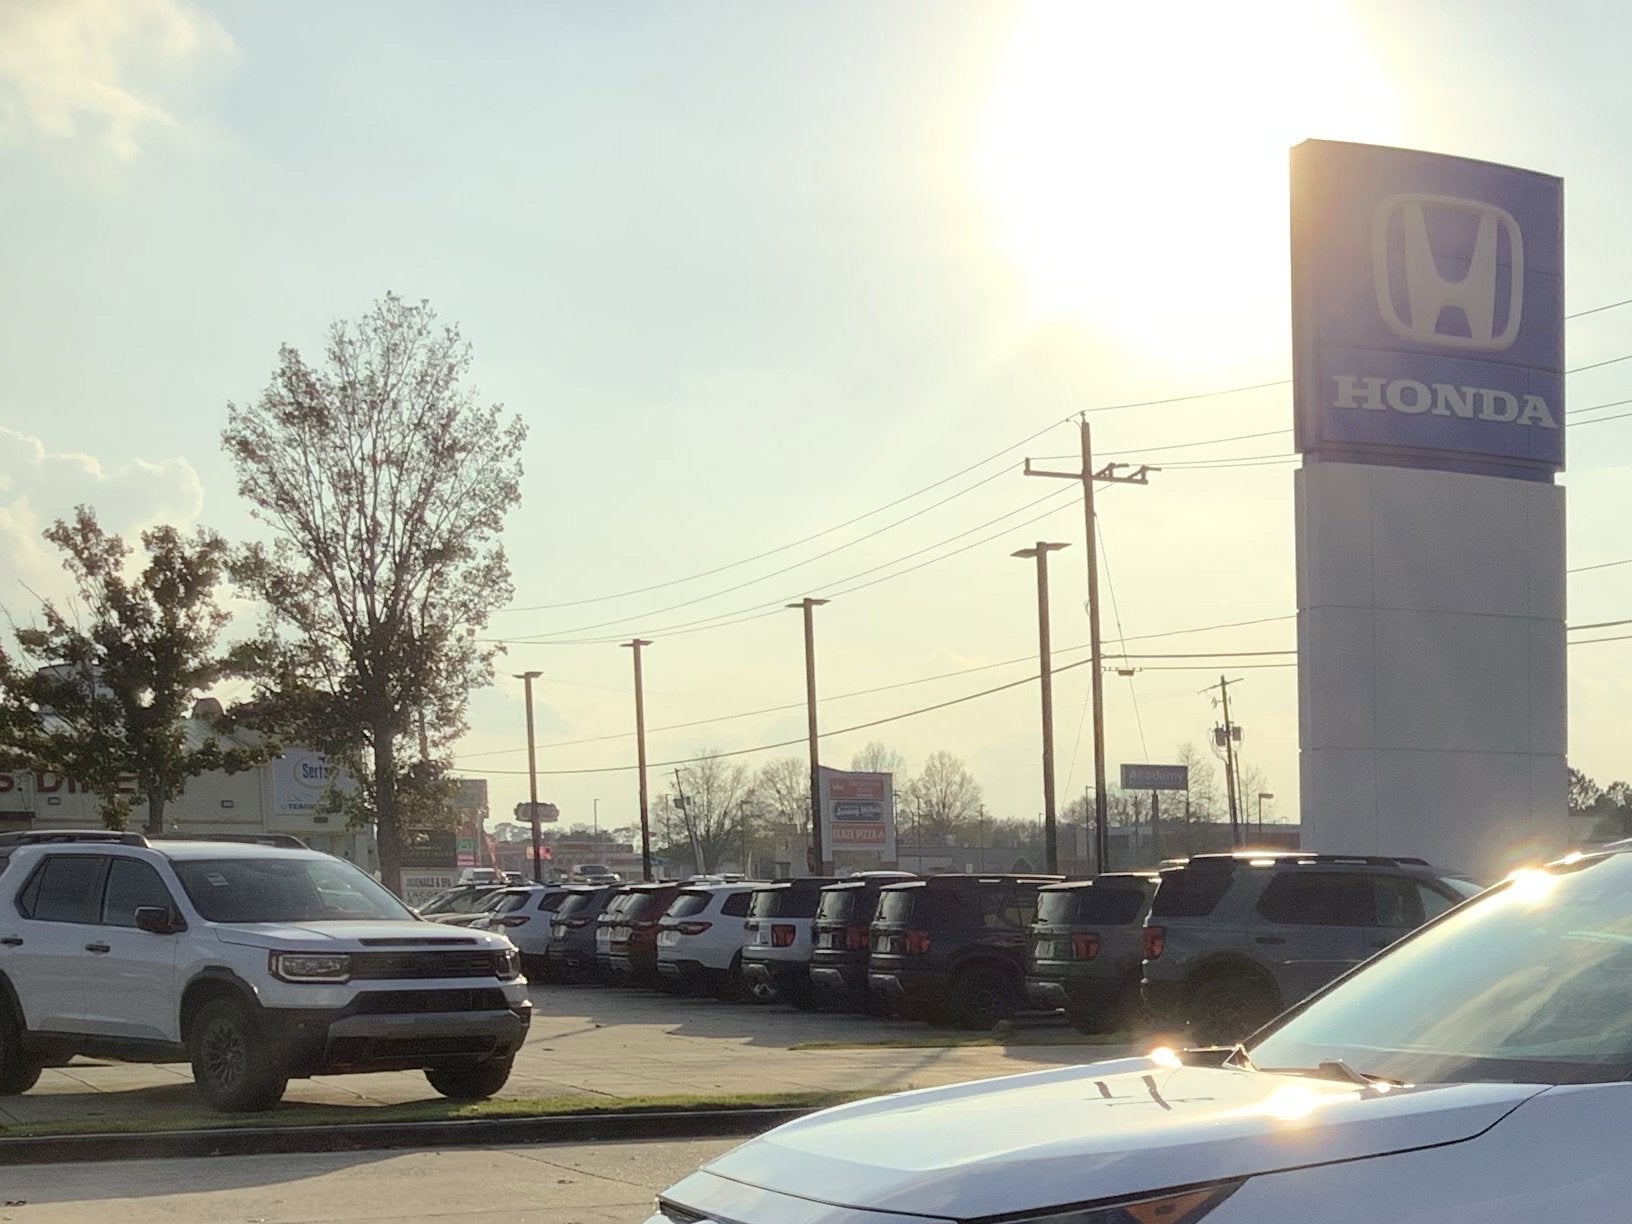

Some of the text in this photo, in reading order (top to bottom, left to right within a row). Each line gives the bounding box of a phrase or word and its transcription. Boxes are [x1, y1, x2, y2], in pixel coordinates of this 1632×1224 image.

[1333, 374, 1559, 429] HONDA
[1128, 769, 1184, 784] Academy
[855, 828, 877, 841] PIZZA
